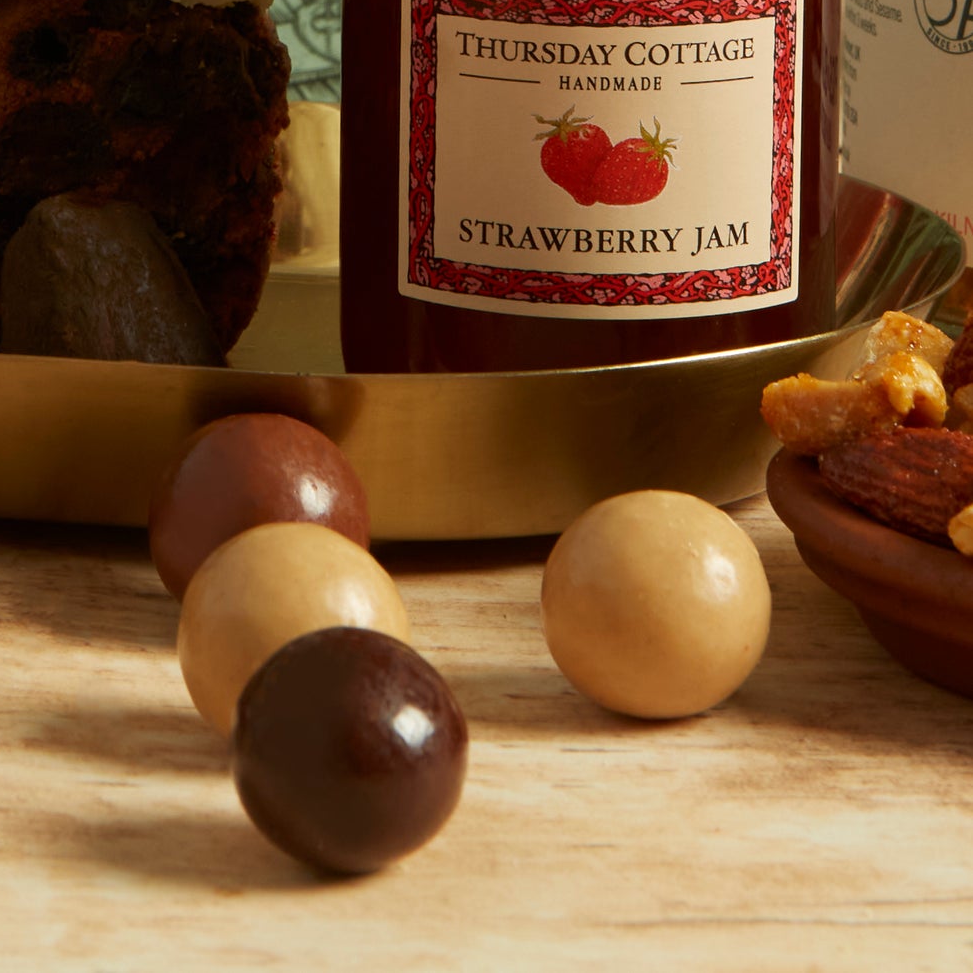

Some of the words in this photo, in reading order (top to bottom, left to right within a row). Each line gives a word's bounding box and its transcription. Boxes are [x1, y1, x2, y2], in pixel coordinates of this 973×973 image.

[456, 31, 617, 65] THURSDAY
[624, 38, 755, 66] COTTAGE
[927, 27, 950, 50] SINCE
[559, 76, 662, 92] HANDMADE
[459, 219, 682, 253] STRAWBERRY
[691, 221, 750, 256] JAM
